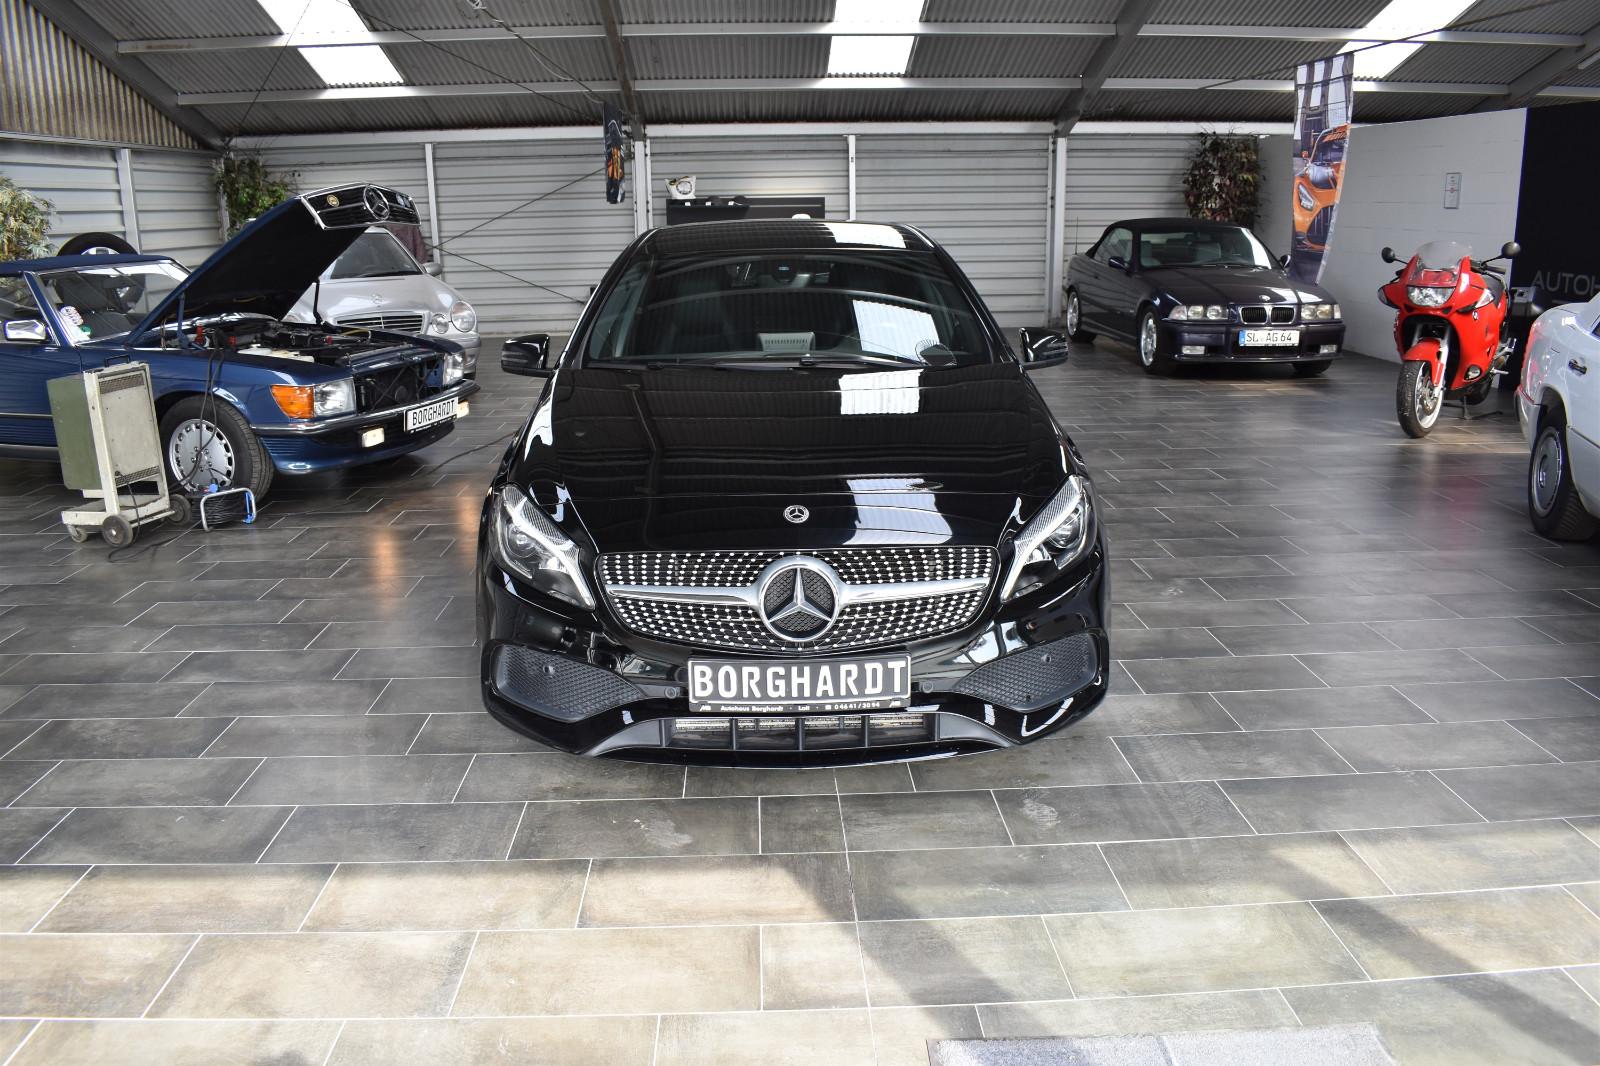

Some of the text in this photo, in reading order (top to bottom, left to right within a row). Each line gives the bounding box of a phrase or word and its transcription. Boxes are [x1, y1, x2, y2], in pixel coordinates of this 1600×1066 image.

[1246, 332, 1292, 342] SL AG 64
[412, 399, 455, 426] BORGHARDT
[693, 660, 906, 698] BORGHARDT
[751, 705, 784, 713] Borghardt
